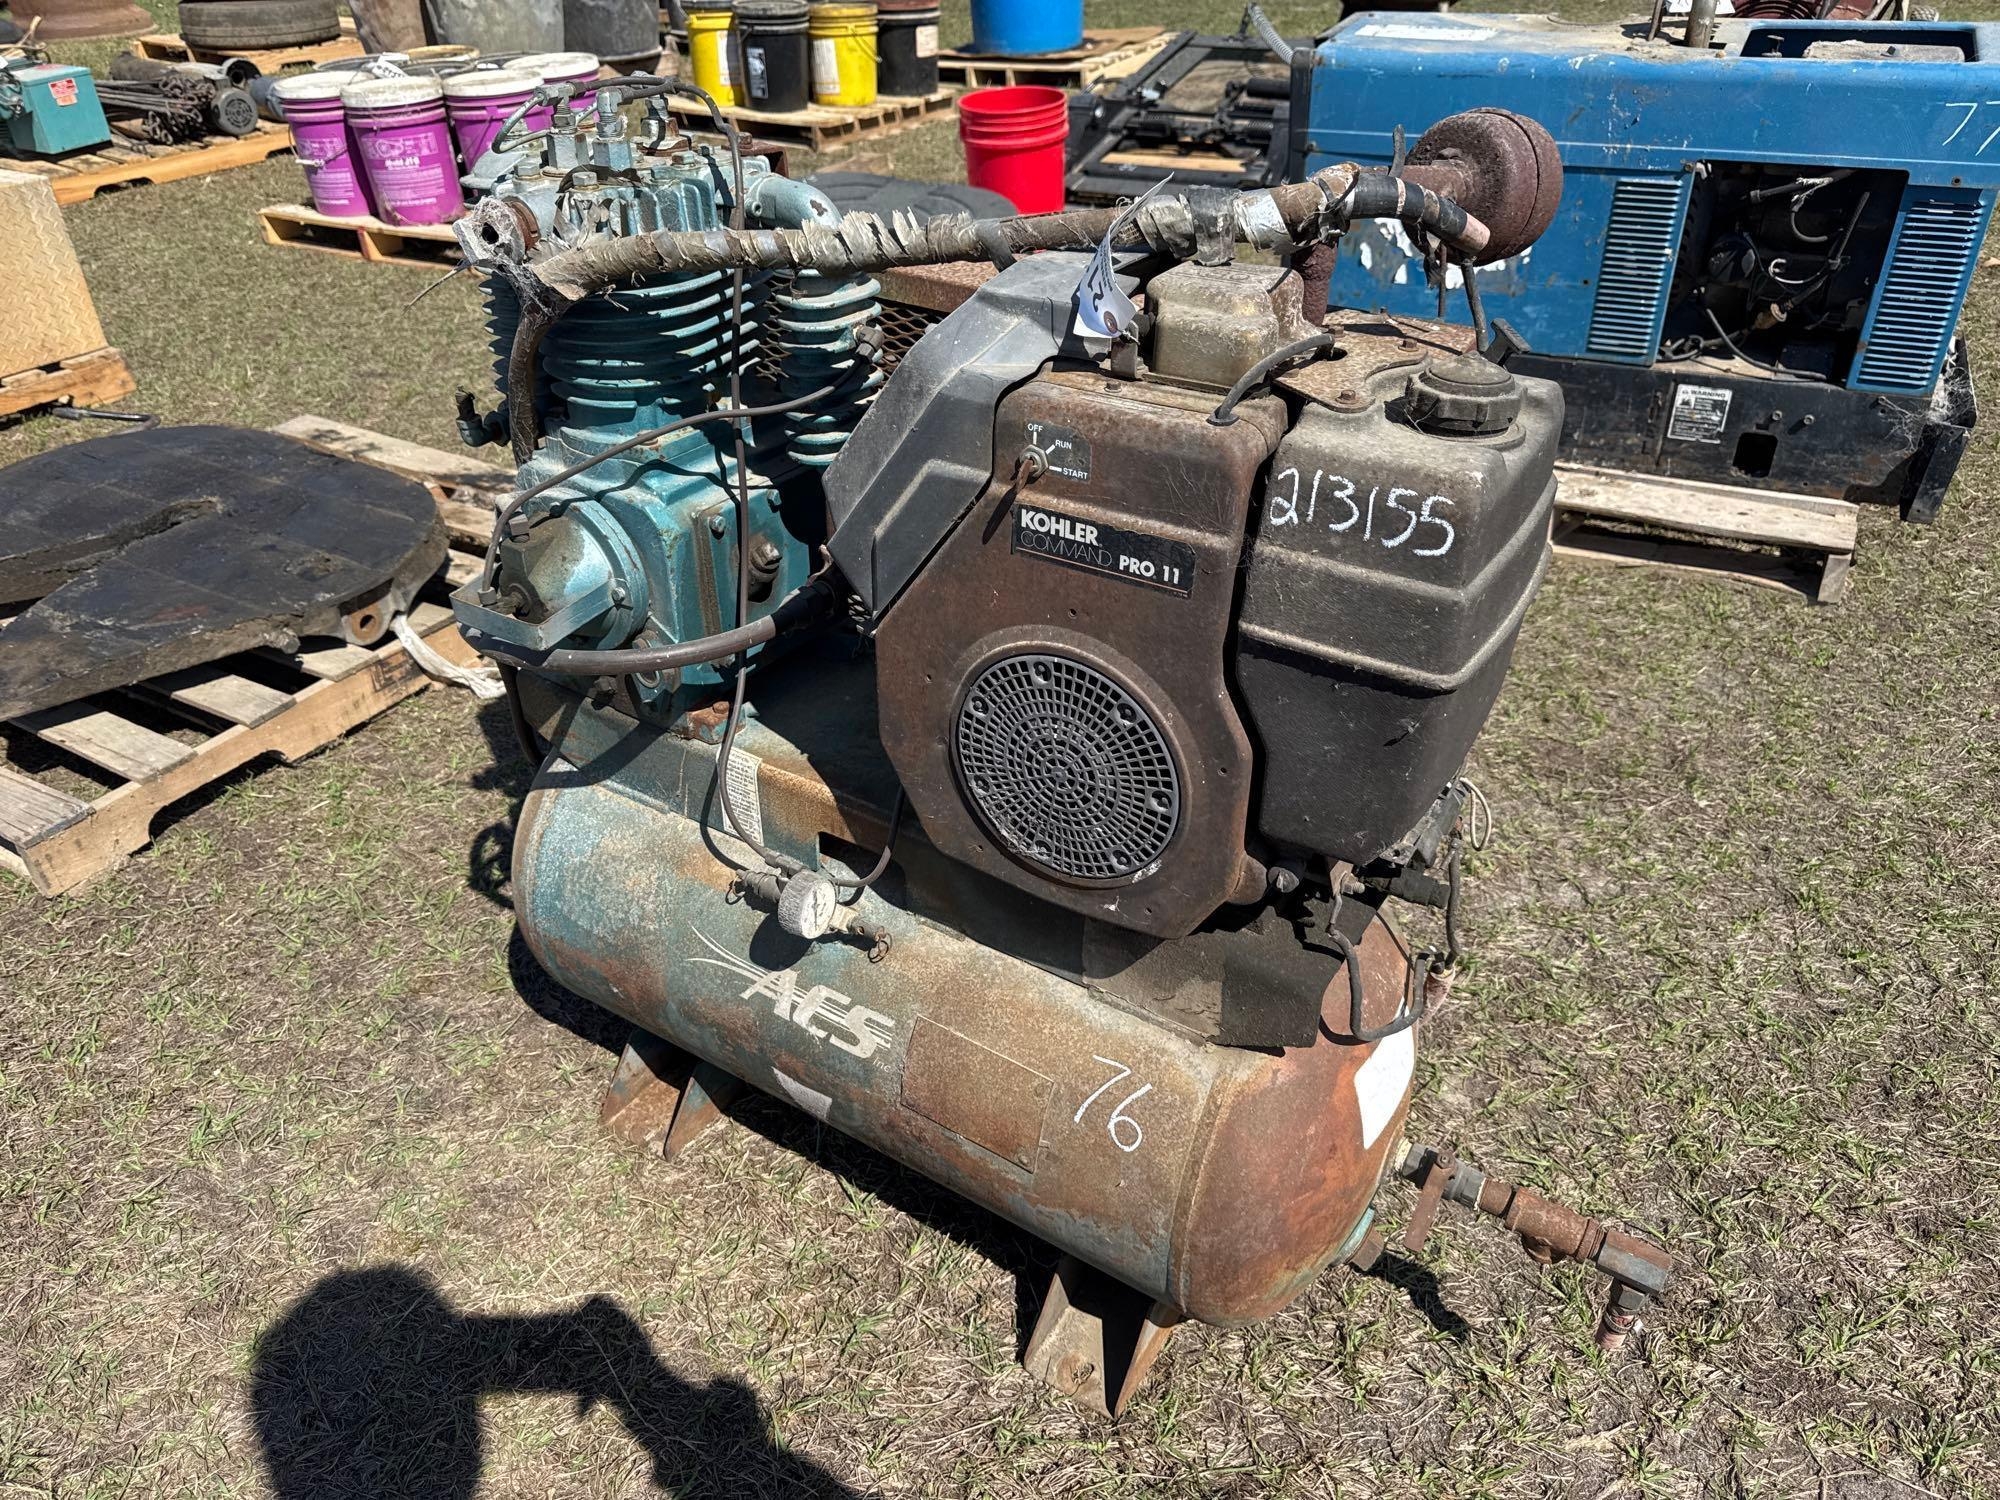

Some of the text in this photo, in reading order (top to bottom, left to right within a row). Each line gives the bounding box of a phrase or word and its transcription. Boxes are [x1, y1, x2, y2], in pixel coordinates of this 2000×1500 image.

[1027, 423, 1043, 432] OFF
[1055, 439, 1072, 450] RUN
[1062, 467, 1088, 480] START
[1021, 508, 1100, 547] KOHLER
[1269, 466, 1456, 557] 213155
[1020, 530, 1180, 585] COMMAND PRO 11
[1073, 1054, 1153, 1152] 76
